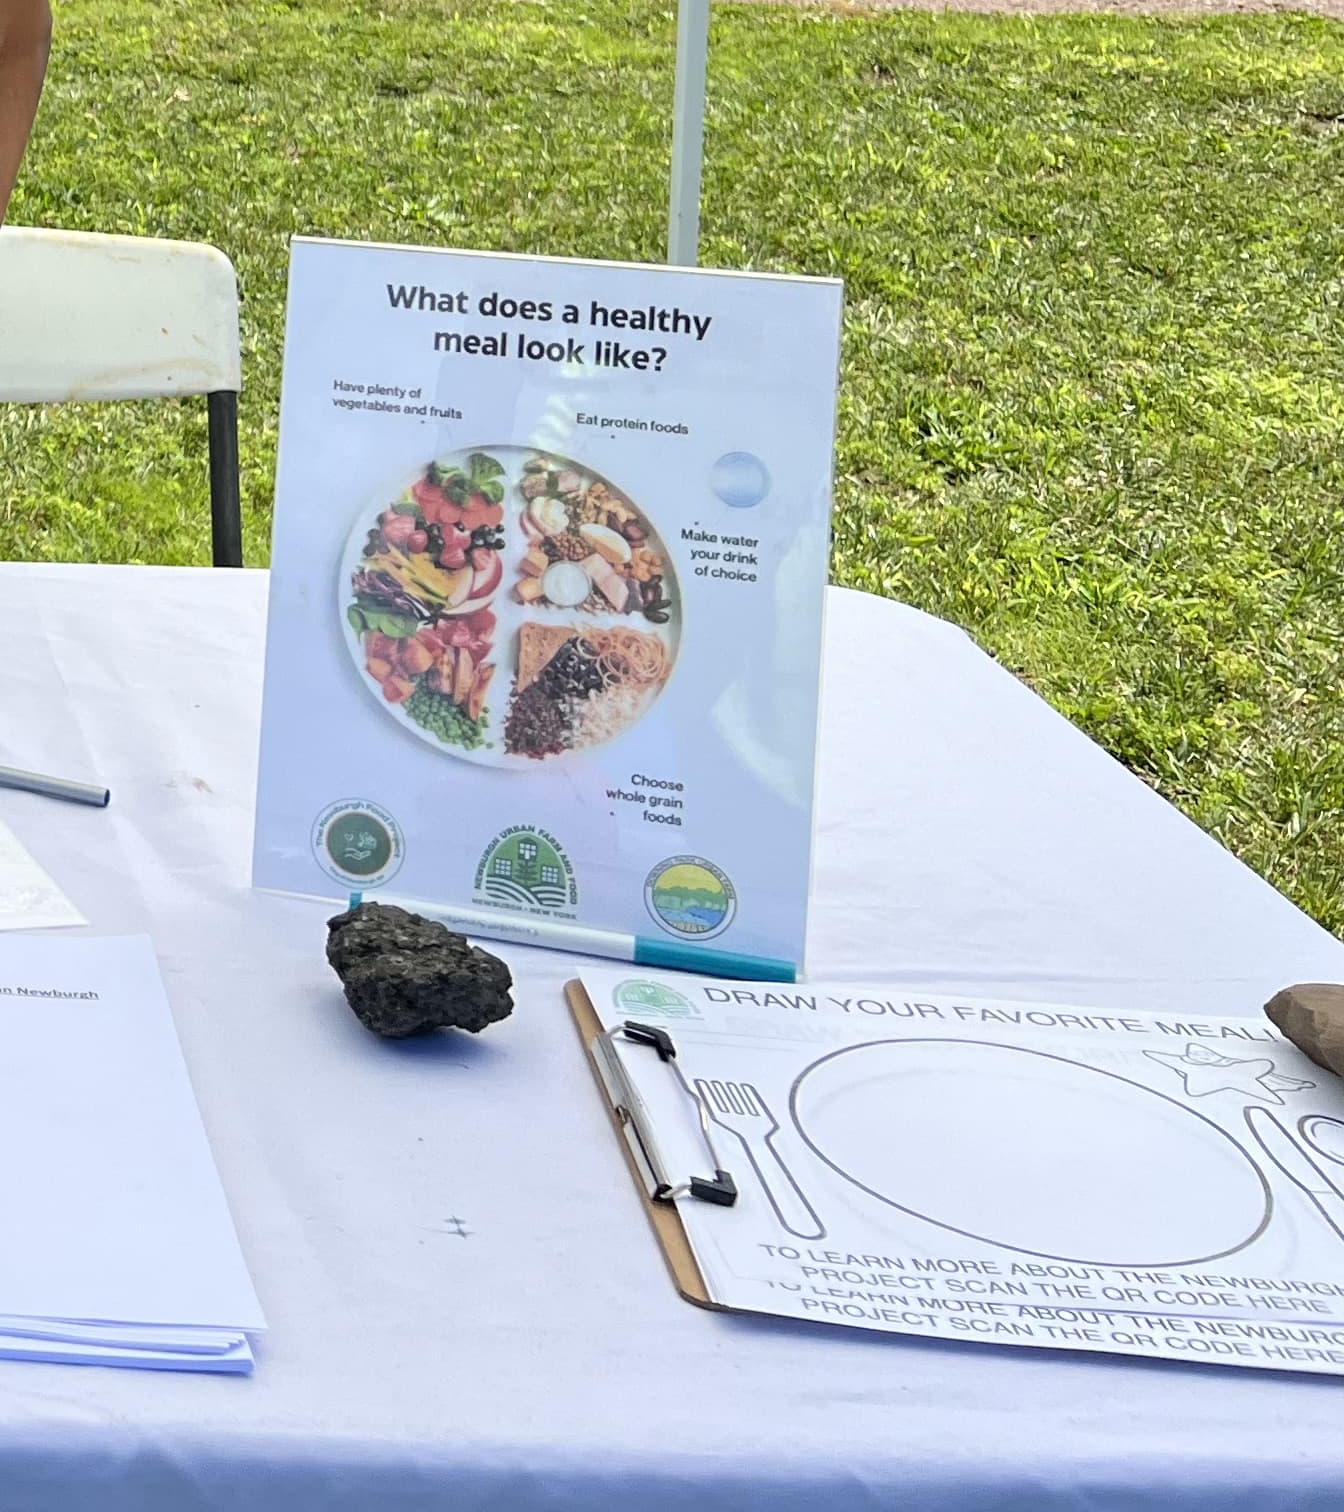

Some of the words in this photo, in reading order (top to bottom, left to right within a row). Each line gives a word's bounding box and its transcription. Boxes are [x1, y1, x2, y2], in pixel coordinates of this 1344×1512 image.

[386, 284, 468, 314] What
[478, 292, 552, 321] does
[561, 304, 579, 324] a
[590, 300, 712, 340] healthy
[434, 331, 507, 356] meal
[517, 333, 584, 364] look
[595, 340, 666, 371] like?
[333, 379, 365, 393] Have
[366, 383, 406, 399] plenty
[408, 387, 422, 398] of
[332, 398, 400, 413] vegetables
[403, 405, 427, 415] and
[429, 405, 462, 419] fruits
[576, 412, 598, 425] Eat
[600, 417, 647, 430] protein
[650, 420, 688, 434] foods
[680, 528, 717, 543] Make
[720, 535, 758, 547] water
[690, 549, 720, 560] your
[722, 550, 757, 565] drink
[694, 565, 708, 576] of
[710, 567, 757, 582] choice
[630, 773, 683, 791] Choose
[605, 788, 646, 803] whole
[648, 795, 682, 808] grain
[643, 809, 681, 826] foods
[703, 987, 816, 1010] DRAW
[827, 997, 944, 1018] YOUR
[953, 1008, 1150, 1033] FAVORITE
[758, 1244, 800, 1260] TO
[807, 1249, 905, 1270] LEARN
[911, 1258, 1001, 1274] MORE
[1011, 1262, 1105, 1282] ABOUT
[1112, 1270, 1177, 1286] THE
[800, 1265, 934, 1290] PROJECT
[944, 1278, 1028, 1295] SCAN
[1031, 1282, 1096, 1299] THE
[1101, 1286, 1148, 1302] QR
[1153, 1289, 1242, 1307] CODE
[1245, 1294, 1331, 1313] HERE
